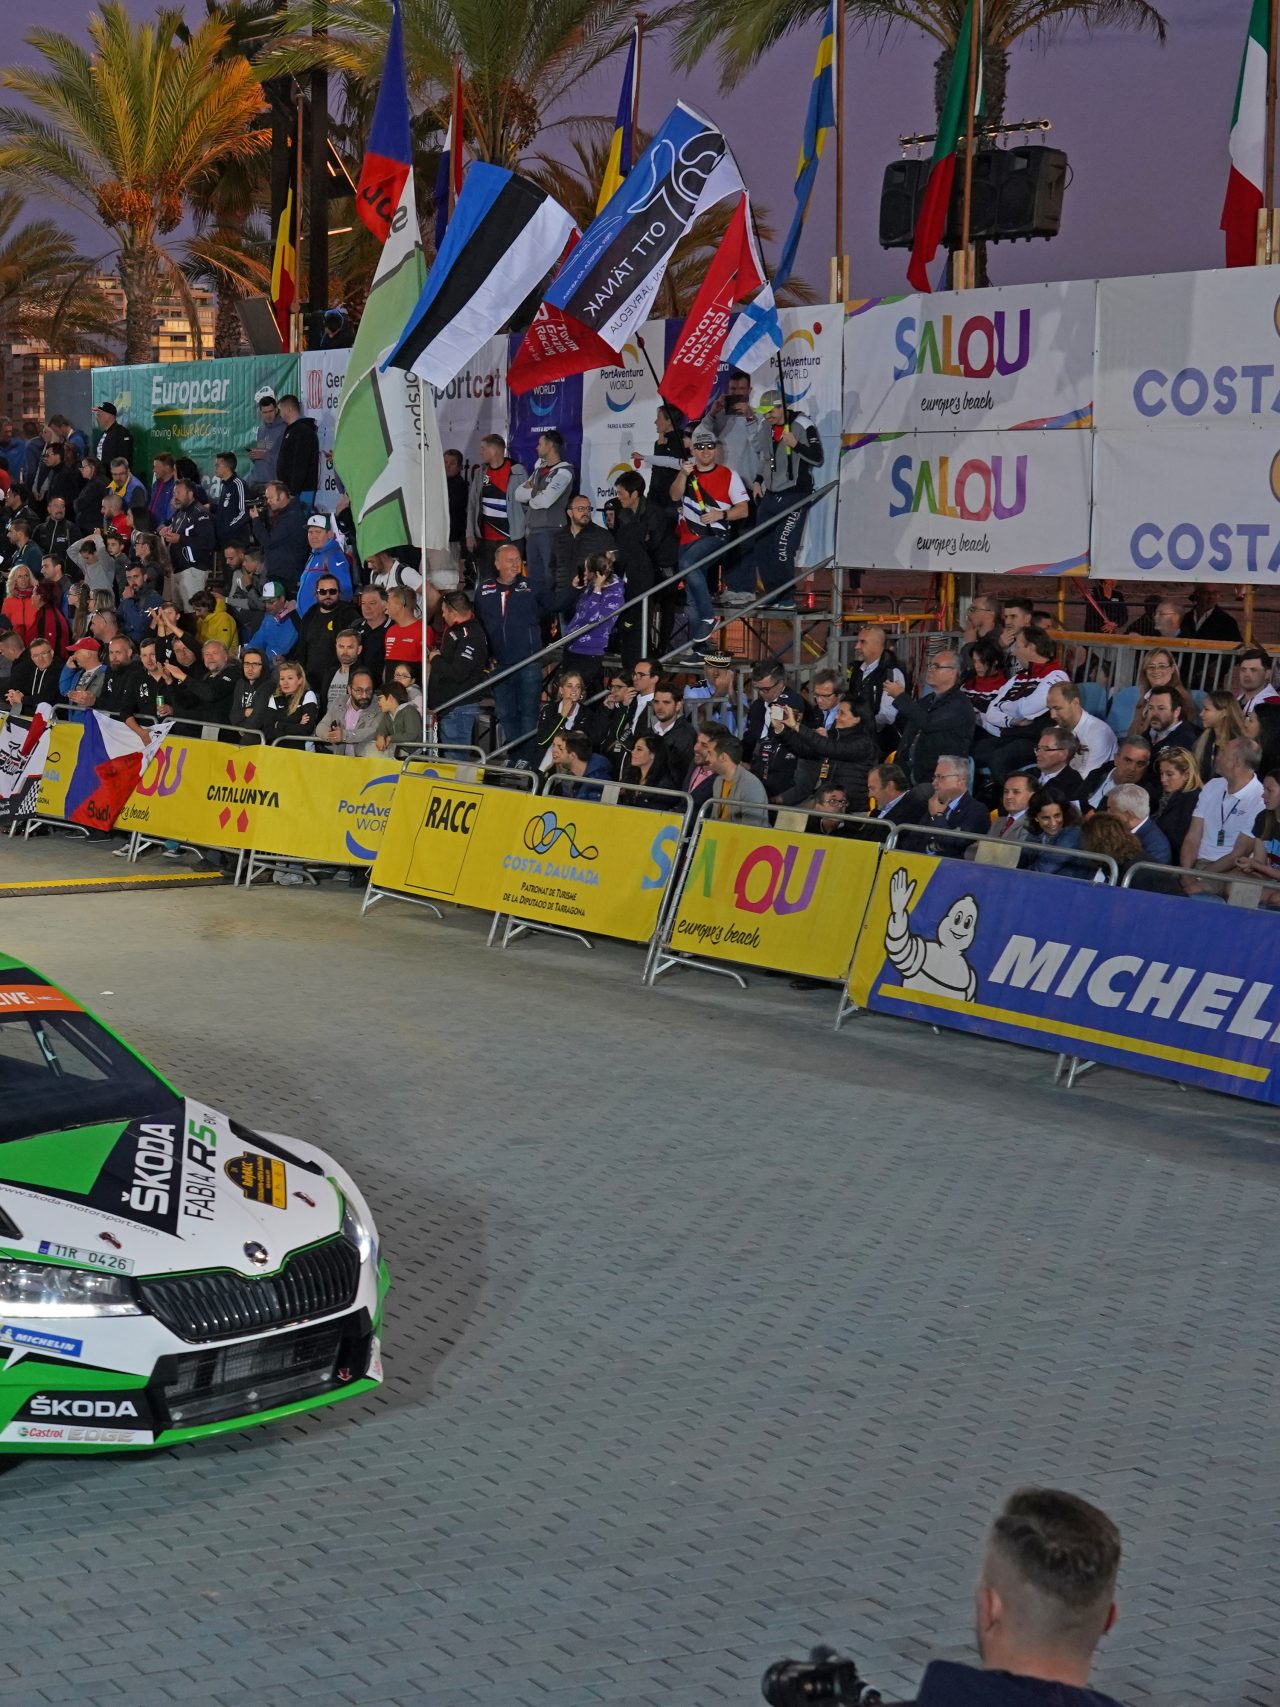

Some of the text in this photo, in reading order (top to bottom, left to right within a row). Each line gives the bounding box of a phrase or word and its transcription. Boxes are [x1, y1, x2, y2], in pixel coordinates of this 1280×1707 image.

[893, 308, 1030, 381] SALOU
[600, 368, 644, 379] PortAventura
[770, 356, 821, 368] PotAventura
[151, 376, 230, 415] Europcar
[533, 385, 556, 395] WORLD
[609, 380, 634, 390] WORLD
[1133, 365, 1280, 418] COST
[920, 391, 994, 415] europe's beach
[889, 454, 1028, 522] SALOU
[779, 510, 800, 563] CALIFORNIA
[917, 533, 990, 556] europe's beach
[1130, 522, 1280, 572] COST
[206, 784, 280, 809] CATALUNYA
[338, 799, 390, 818] PortAve
[356, 817, 387, 832] WOR
[424, 796, 477, 835] RACC
[502, 854, 600, 886] COSTA DAURADA
[677, 919, 761, 948] europe's beach
[987, 934, 1280, 1044] MICHEL
[121, 1123, 176, 1215] ŠKODA
[184, 1172, 216, 1221] FABIA
[88, 1252, 127, 1271] 0426
[15, 1332, 76, 1353] MICHELIN
[30, 1395, 138, 1418] ŠKODA
[29, 1427, 133, 1443] Castrol EDGE
